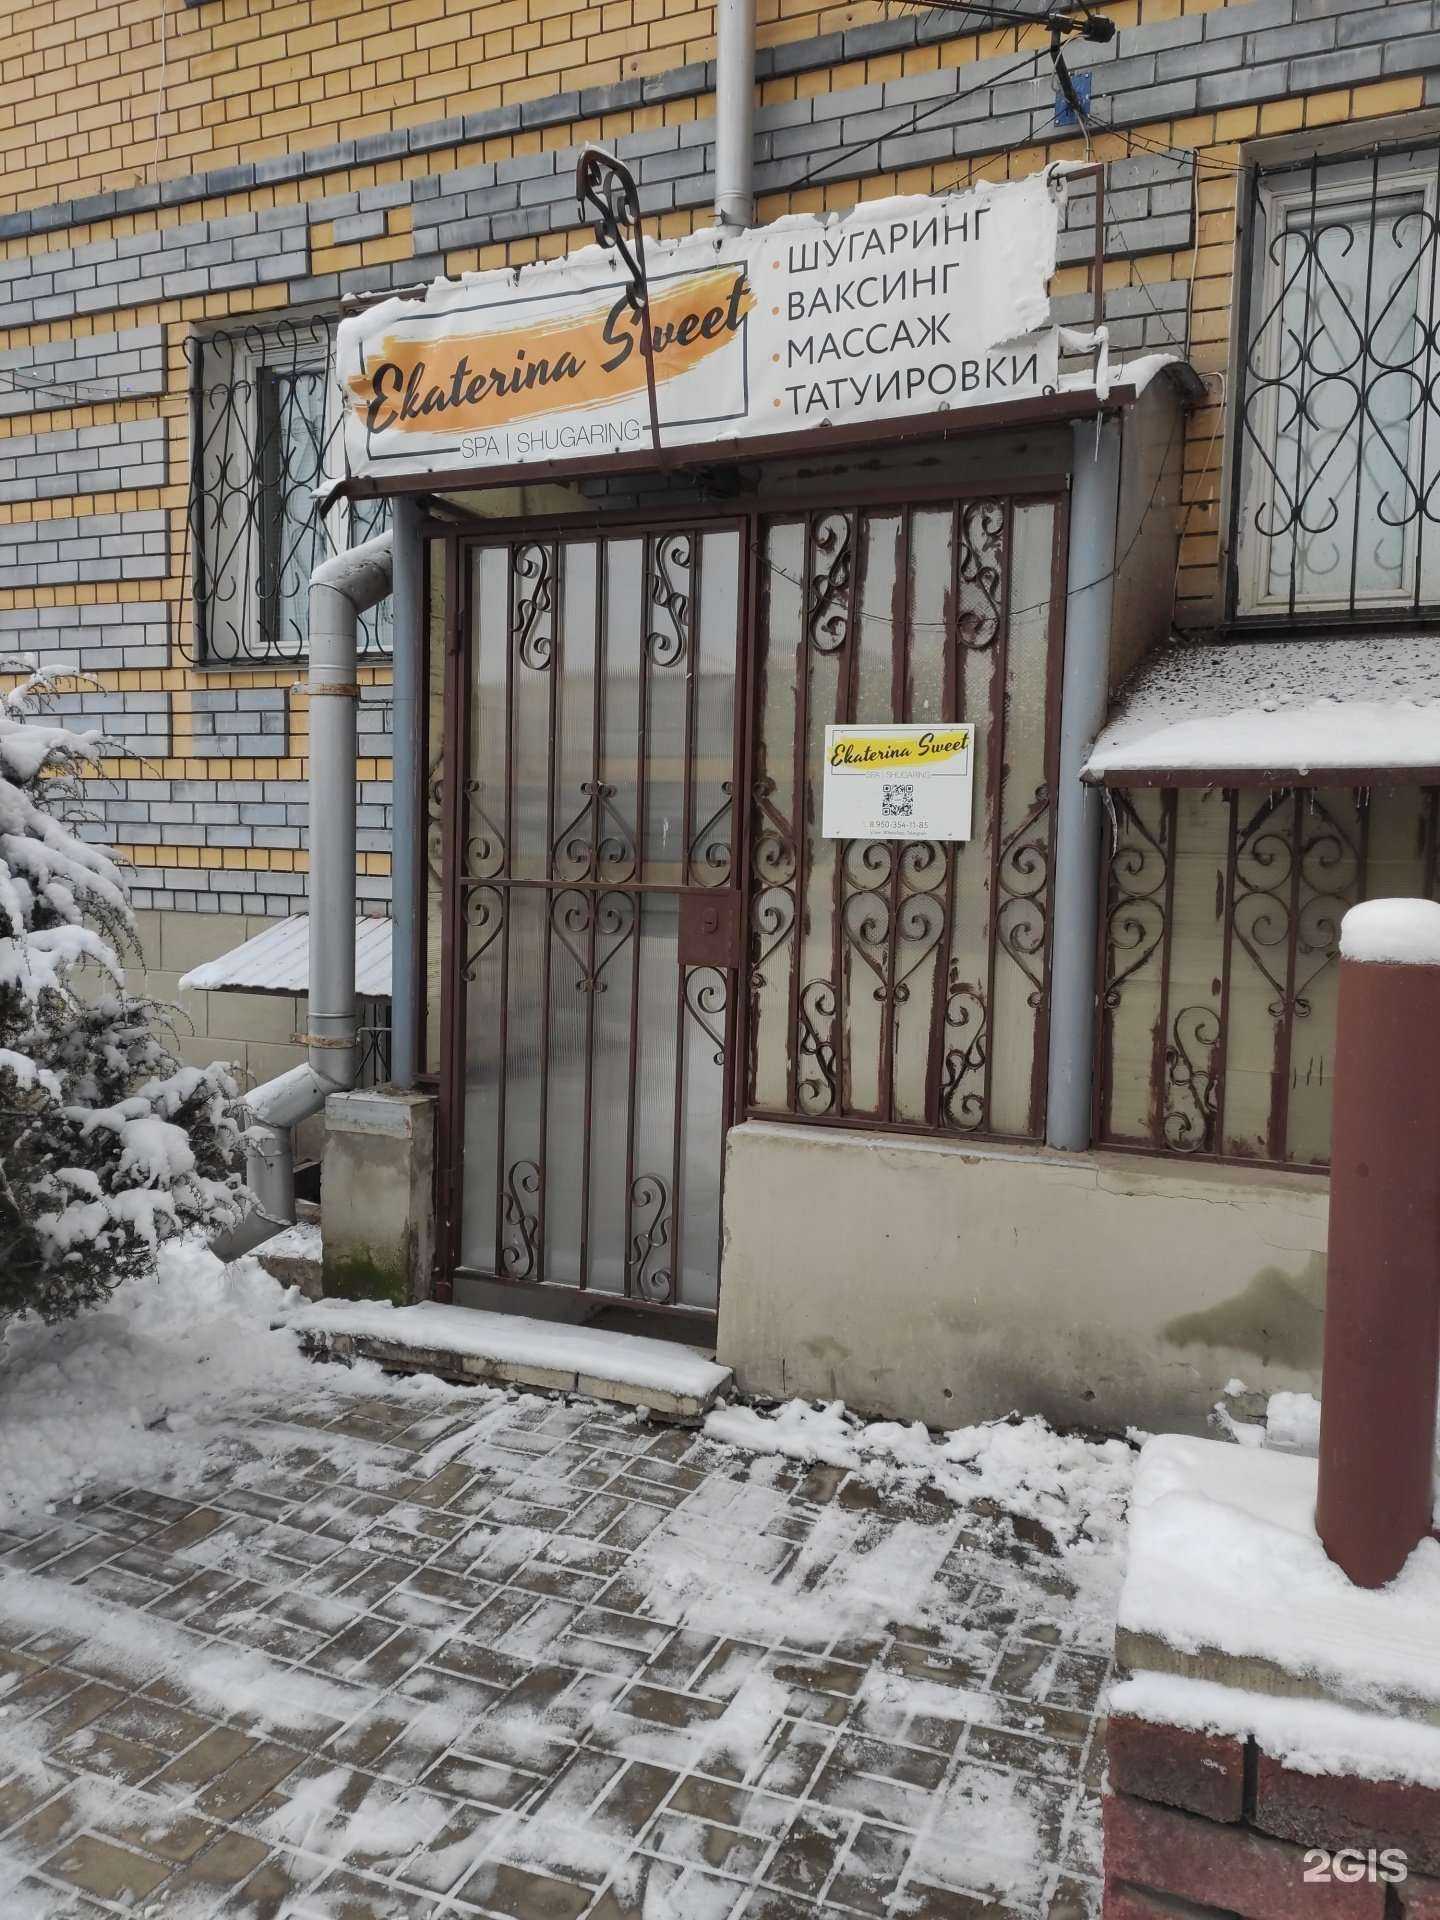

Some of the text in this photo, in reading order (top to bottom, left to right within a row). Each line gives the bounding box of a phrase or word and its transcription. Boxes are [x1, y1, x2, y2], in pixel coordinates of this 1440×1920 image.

[787, 207, 992, 274] ШУГАРИНГ
[787, 262, 960, 321] ВАКСИНГ
[787, 312, 952, 369] МАССАЖ
[367, 349, 587, 435] Ekaterina
[784, 353, 1038, 416] ТАТУИРОВКИ
[461, 418, 641, 459] SPA SHUGARING
[830, 732, 970, 767] Ekaterina Sweet
